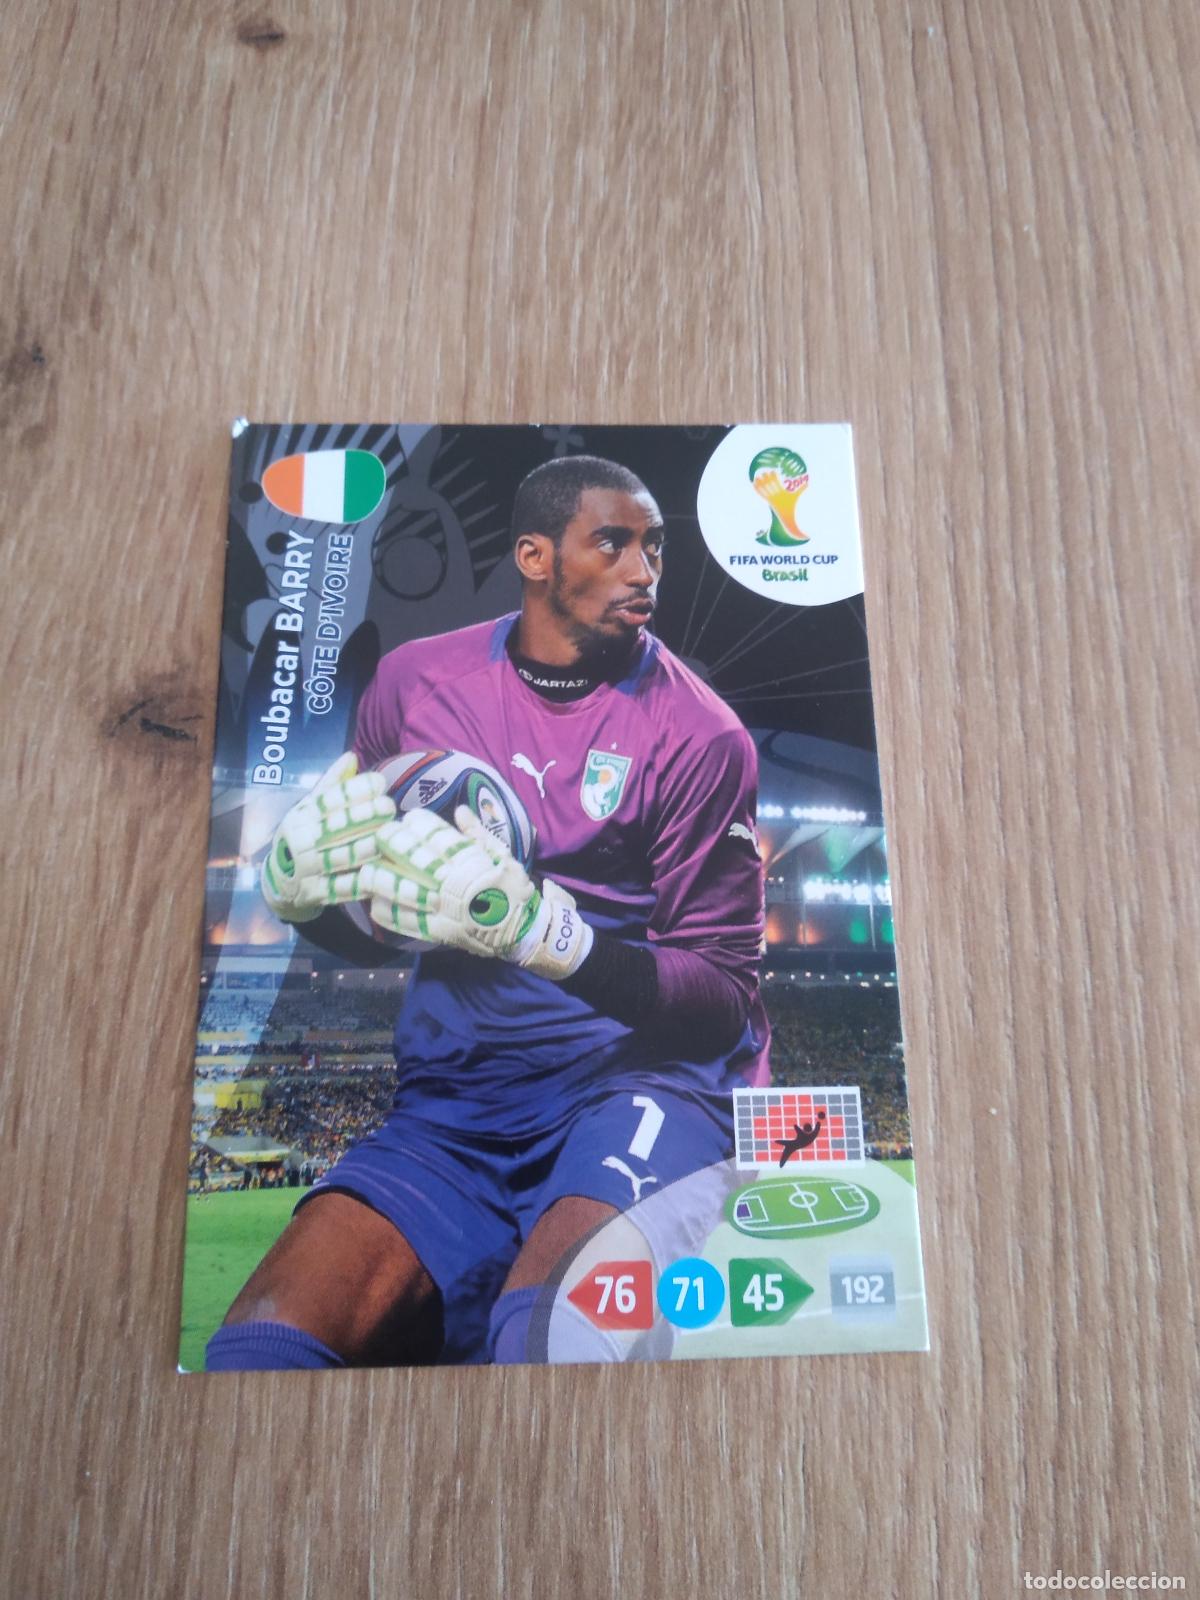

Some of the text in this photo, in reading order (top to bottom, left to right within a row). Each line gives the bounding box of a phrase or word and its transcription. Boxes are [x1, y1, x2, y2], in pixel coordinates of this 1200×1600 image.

[729, 555, 838, 566] FIFA WORLD CUP
[762, 568, 808, 582] Brasil
[303, 533, 354, 715] CÔTE D'IVOIRE
[252, 530, 315, 786] Boubacar BARRY
[594, 1275, 637, 1315] 76
[672, 1276, 706, 1312] 71
[742, 1273, 785, 1312] 45
[841, 1275, 886, 1304] 192
